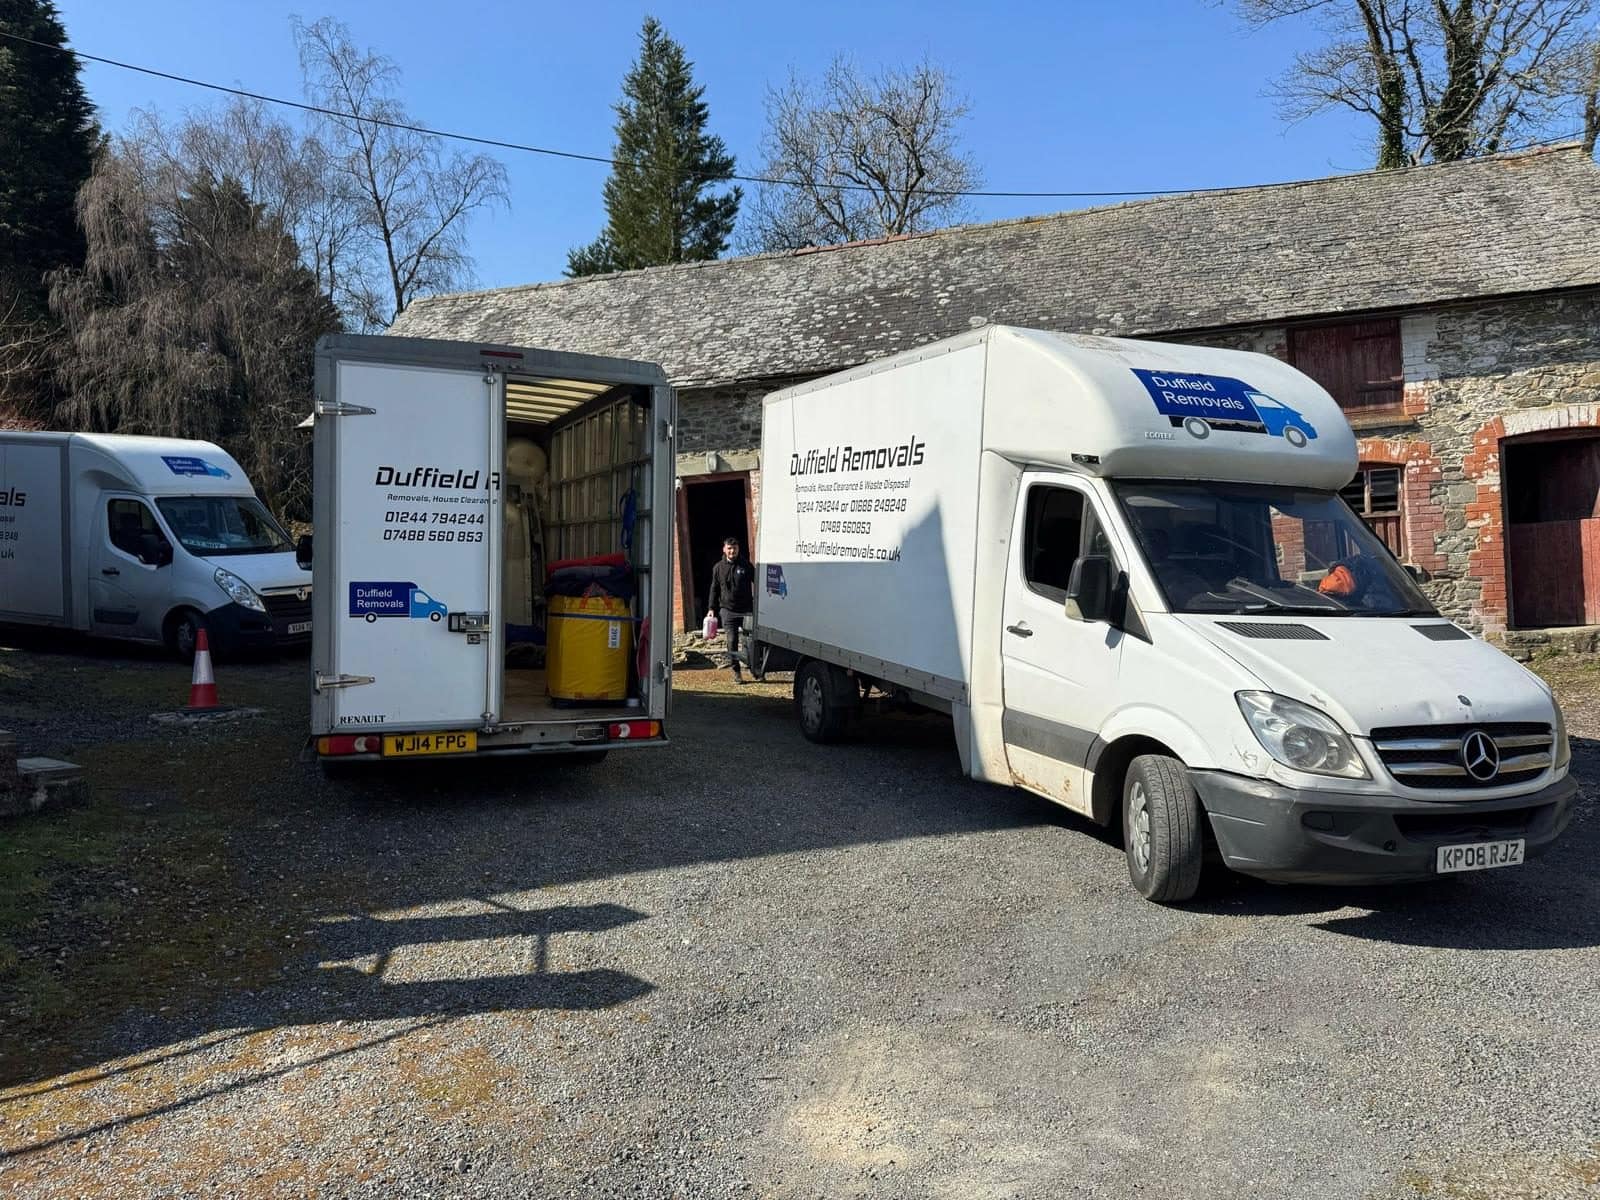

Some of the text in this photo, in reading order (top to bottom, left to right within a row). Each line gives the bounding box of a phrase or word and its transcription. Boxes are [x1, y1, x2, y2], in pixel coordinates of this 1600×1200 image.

[1151, 376, 1216, 391] Duffield
[1162, 391, 1245, 410] Removals
[790, 434, 925, 476] Duffield Removals
[375, 466, 480, 490] Duffield
[883, 477, 911, 491] Disposal
[432, 495, 459, 504] House
[815, 500, 839, 512] 794244
[840, 503, 849, 512] or
[850, 499, 873, 512] 01686
[874, 498, 907, 512] 249248
[384, 511, 485, 525] 01244 794244
[820, 520, 872, 534] 07488 560853
[383, 529, 483, 543] 07488 560 853
[356, 589, 393, 598] Duffield
[357, 599, 404, 608] Removals
[340, 715, 386, 724] RENAULT
[395, 734, 466, 752] WJ14 FPG
[1443, 843, 1519, 870] KP08 RJZ
